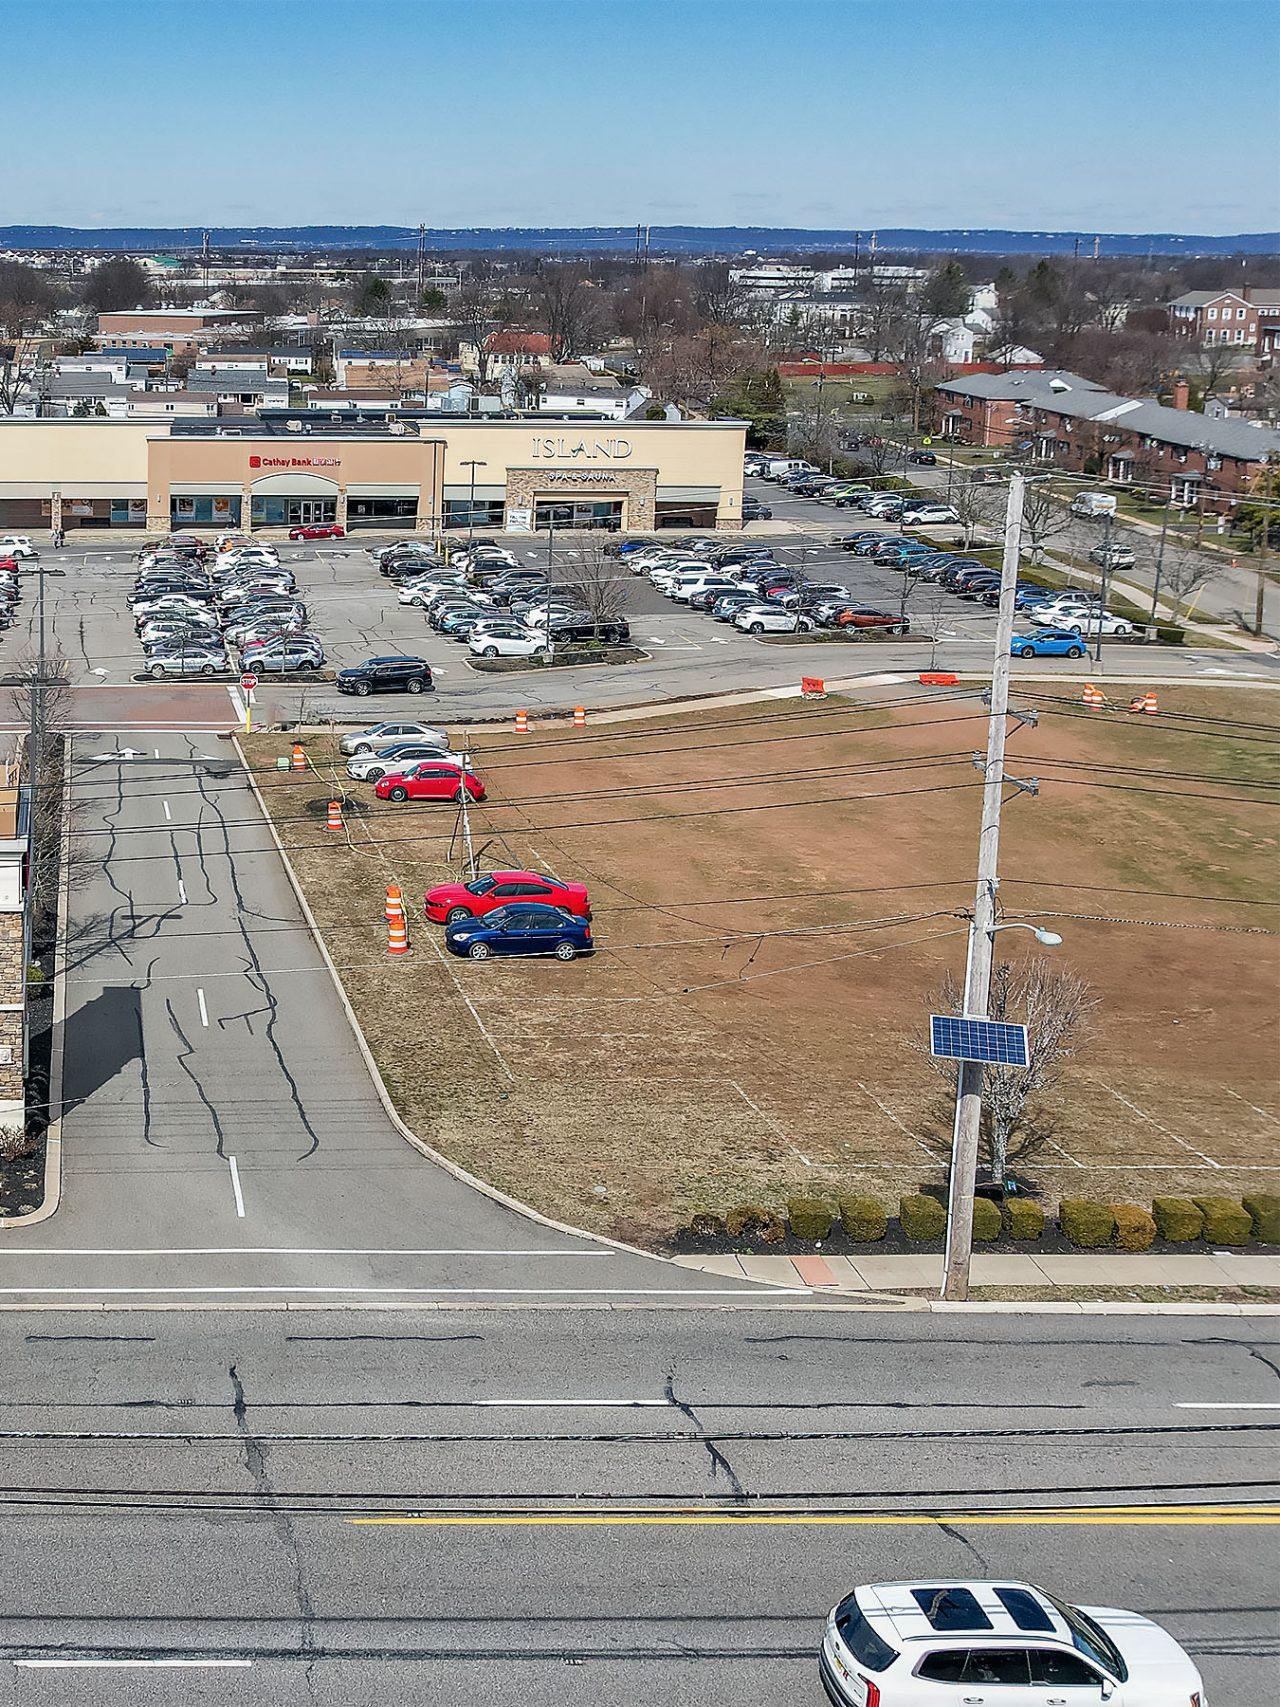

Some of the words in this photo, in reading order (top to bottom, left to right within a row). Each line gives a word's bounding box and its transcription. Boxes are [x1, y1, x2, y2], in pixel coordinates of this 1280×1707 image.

[532, 438, 632, 458] ISLAND
[262, 458, 290, 467] Cathay
[291, 458, 312, 466] Bank
[549, 473, 568, 482] SPA
[581, 473, 616, 482] SAUNA
